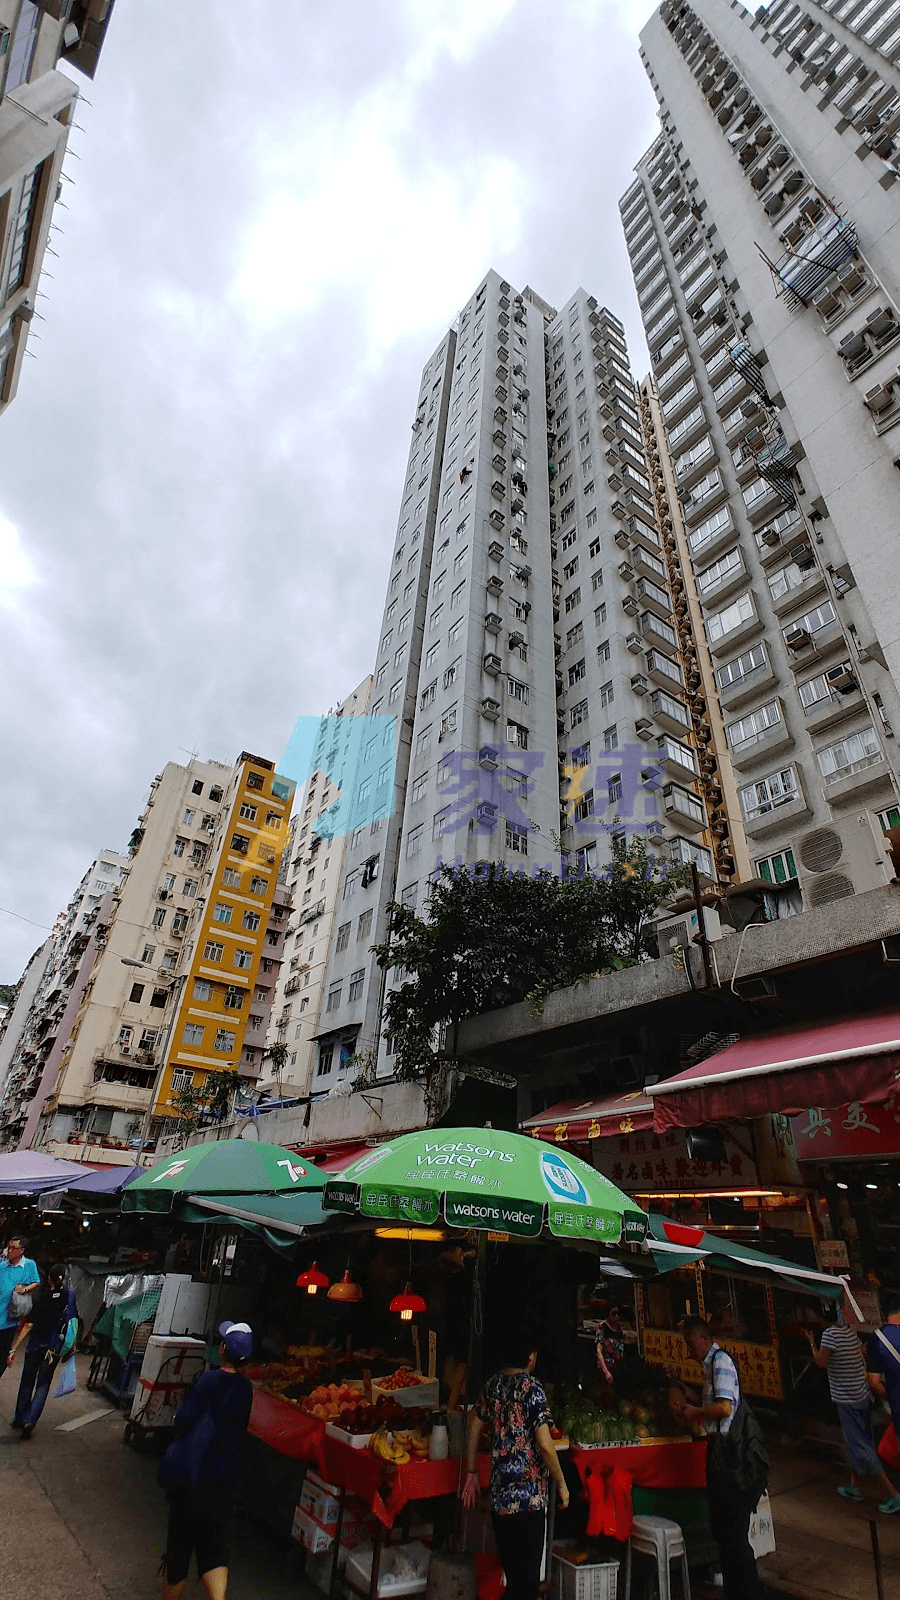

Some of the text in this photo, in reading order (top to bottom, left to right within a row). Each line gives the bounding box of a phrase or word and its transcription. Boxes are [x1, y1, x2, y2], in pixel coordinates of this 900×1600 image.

[416, 1152, 484, 1168] water
[424, 1142, 516, 1163] watsons
[453, 1203, 536, 1225] watsons water
